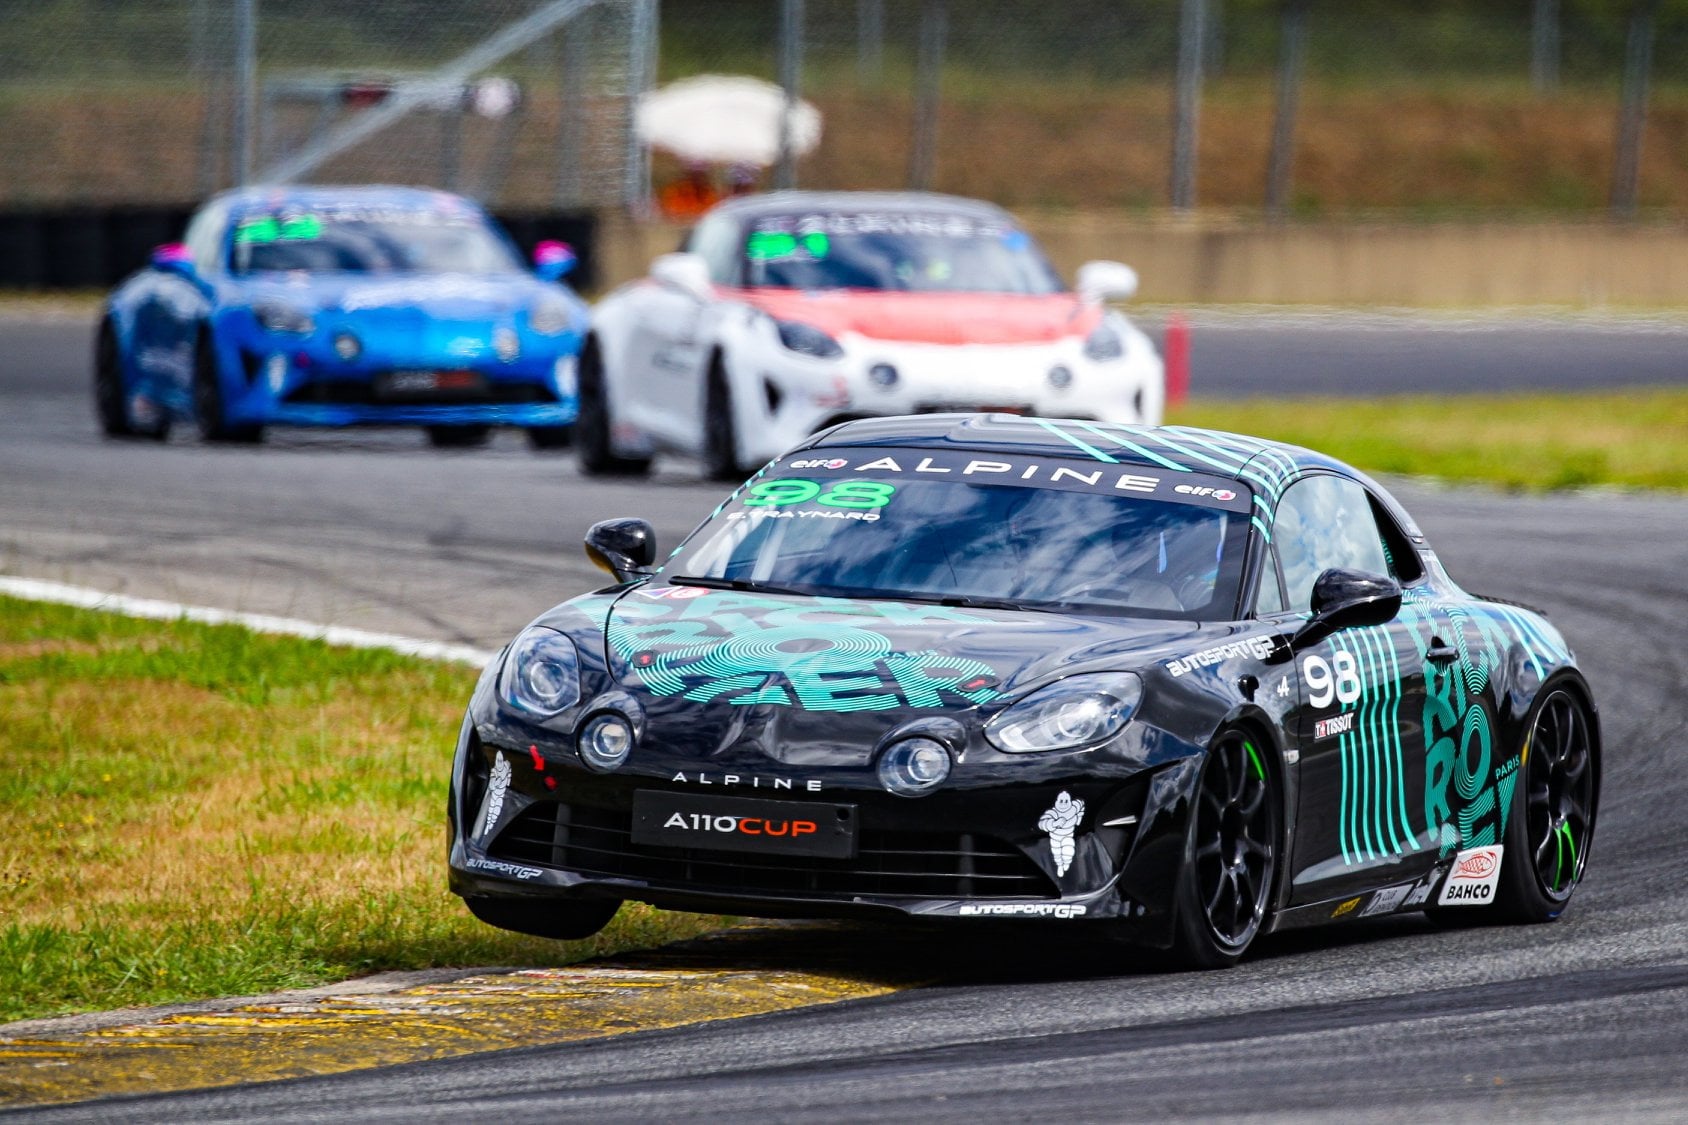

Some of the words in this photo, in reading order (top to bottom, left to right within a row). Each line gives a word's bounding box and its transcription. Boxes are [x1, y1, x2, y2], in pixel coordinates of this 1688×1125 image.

[854, 456, 1161, 493] ALPINE
[743, 478, 896, 509] 98
[1303, 650, 1361, 709] 98
[1495, 754, 1520, 780] PARIS
[672, 772, 822, 791] ALPINE
[1447, 884, 1491, 900] BAHCO
